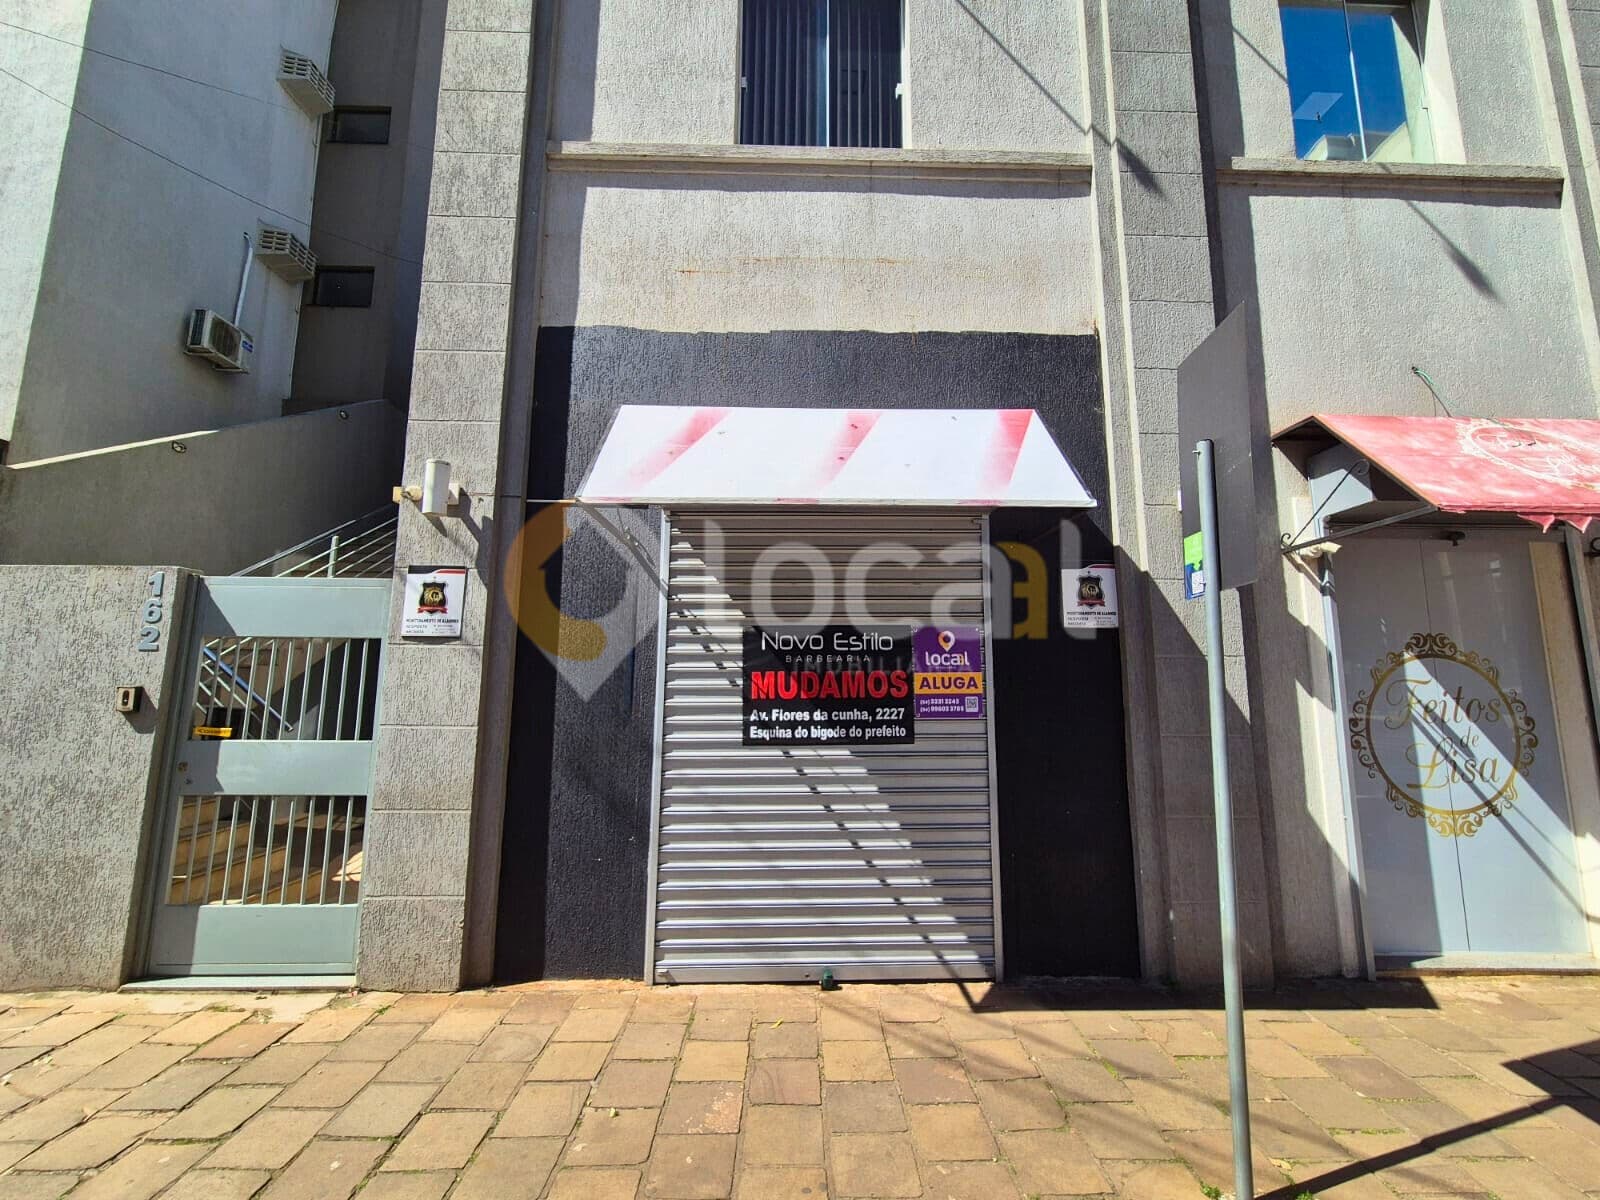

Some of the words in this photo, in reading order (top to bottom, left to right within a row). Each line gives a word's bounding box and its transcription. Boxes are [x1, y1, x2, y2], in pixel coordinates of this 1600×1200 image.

[138, 571, 165, 652] 162
[761, 631, 824, 651] Novo
[833, 631, 893, 651] Estilo
[785, 654, 871, 663] BARBEARIA
[751, 670, 909, 700] MUDAMOS
[919, 676, 979, 690] ALUGA
[1384, 679, 1500, 729] Feitos
[750, 709, 769, 722] Av.
[771, 708, 810, 722] Flores
[813, 708, 829, 722] da
[831, 708, 872, 723] cunha,
[875, 707, 905, 721] 2227
[750, 726, 792, 741] Esquina
[794, 726, 808, 739] do
[810, 726, 847, 741] bigode
[849, 726, 862, 738] do
[865, 725, 907, 740] prefeito
[1460, 726, 1480, 747] de
[1405, 737, 1500, 789] Lisa
